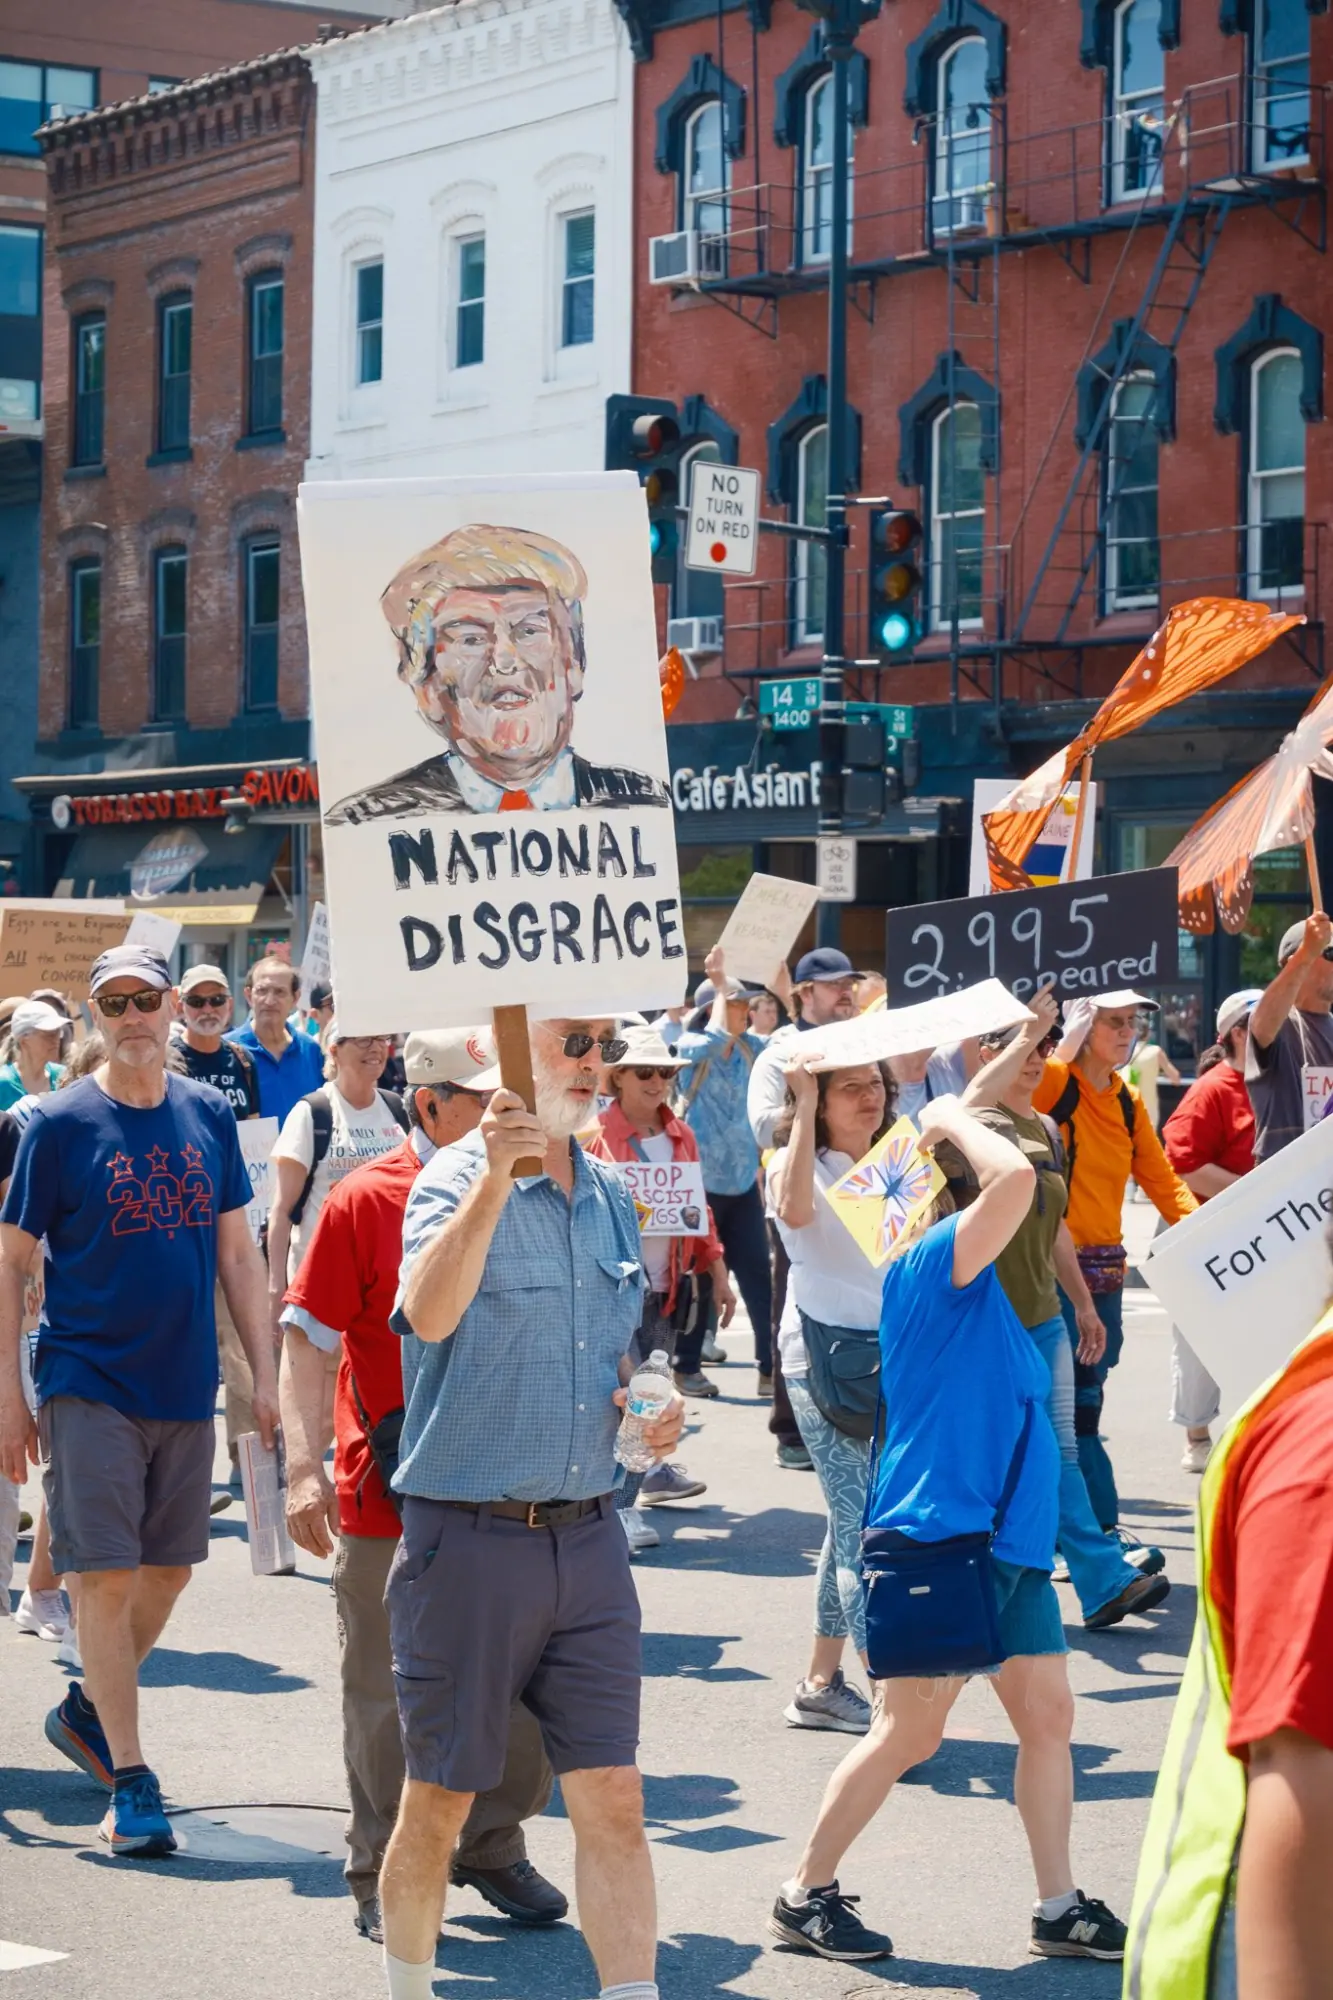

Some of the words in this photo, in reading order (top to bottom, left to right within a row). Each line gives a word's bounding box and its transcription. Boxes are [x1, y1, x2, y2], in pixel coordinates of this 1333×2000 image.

[711, 473, 740, 495] NO
[706, 497, 743, 517] TURN
[695, 517, 716, 535] ON
[722, 521, 750, 539] RED
[772, 685, 793, 708] 14
[805, 682, 817, 694] St
[774, 709, 811, 727] 1400
[893, 709, 906, 722] St
[672, 765, 727, 812] Cafe
[732, 763, 808, 809] Asian
[72, 789, 170, 826] TOBACCO
[387, 820, 657, 891] NATIONAL
[8, 914, 34, 934] Eggs
[399, 893, 684, 972] DISGRACE
[55, 932, 104, 945] Because
[5, 951, 27, 965] All
[37, 952, 56, 964] the
[221, 1074, 236, 1086] OF
[625, 1165, 683, 1189] STOP
[631, 1188, 694, 1206] ASCIST
[650, 1207, 680, 1227] IGS
[1203, 1234, 1268, 1292] For
